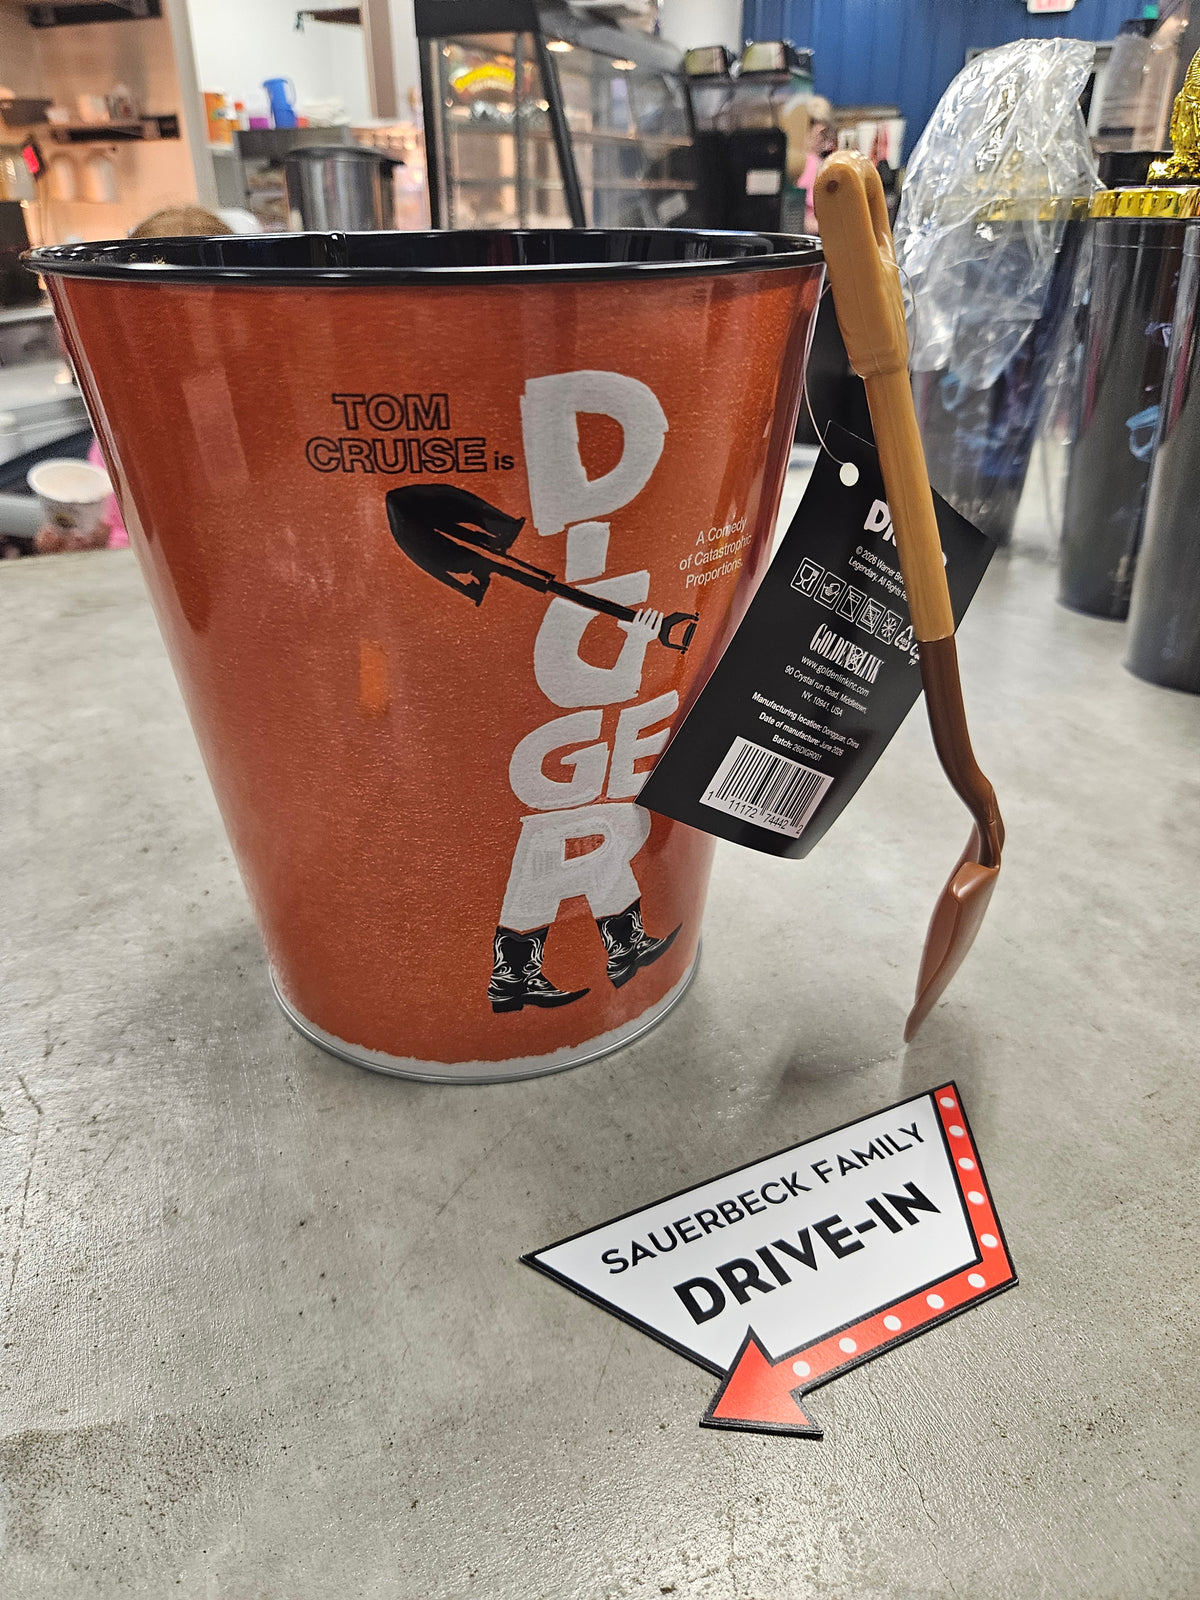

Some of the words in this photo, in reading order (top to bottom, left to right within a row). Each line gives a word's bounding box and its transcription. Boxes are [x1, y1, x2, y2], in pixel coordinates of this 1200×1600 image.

[331, 393, 451, 431] TOM
[305, 436, 488, 474] CRUISE
[493, 450, 515, 471] is
[695, 530, 705, 546] A
[707, 516, 748, 542] Comedy
[679, 553, 693, 571] of
[694, 533, 753, 566] Catastrophic
[861, 549, 878, 565] 2026
[876, 559, 896, 577] Warner
[877, 575, 888, 586] All
[885, 580, 901, 597] Rights
[784, 665, 794, 676] 90
[793, 667, 815, 686] Crystal
[813, 681, 825, 692] run
[823, 685, 839, 699] Road,
[801, 656, 870, 698] www.goldenlinkinc.com
[751, 691, 798, 721] Manufacturing
[797, 713, 822, 731] location:
[846, 737, 860, 749] China
[801, 690, 813, 702] NY,
[830, 704, 844, 717] USA
[758, 711, 776, 725] Date
[775, 721, 785, 729] of
[782, 724, 820, 746] manufacture:
[819, 740, 833, 752] June
[772, 734, 793, 749] Batch:
[707, 790, 715, 801] 1
[728, 799, 758, 819] 11172
[763, 813, 790, 830] 74442
[795, 824, 804, 834] 2
[601, 1171, 812, 1274] SAUERBECK
[810, 1121, 925, 1183] FAMILY
[673, 1181, 942, 1325] DRIVE-IN
